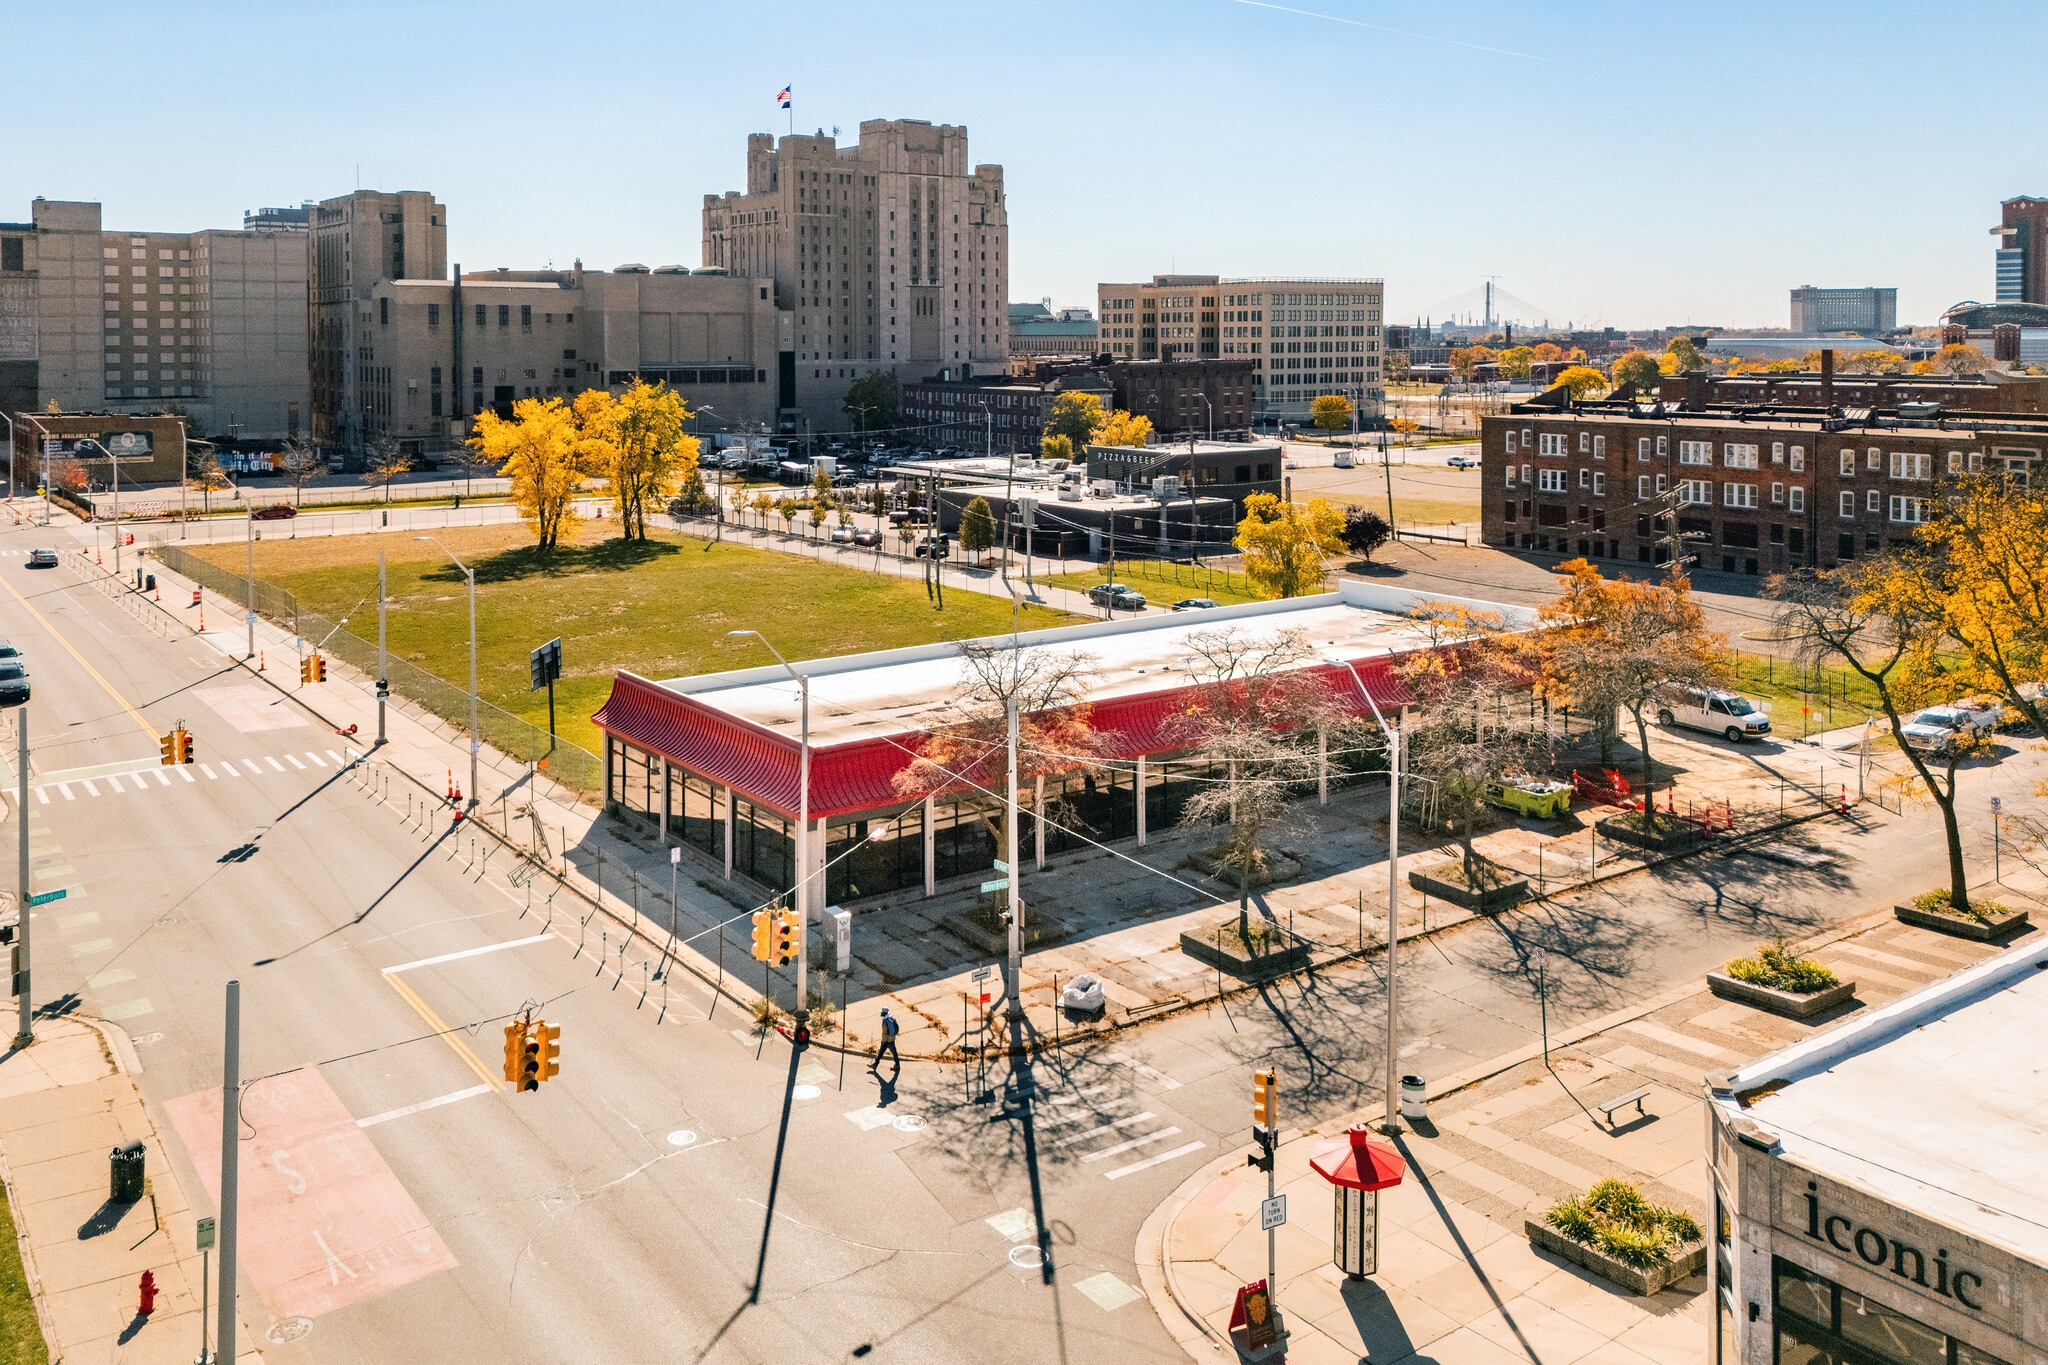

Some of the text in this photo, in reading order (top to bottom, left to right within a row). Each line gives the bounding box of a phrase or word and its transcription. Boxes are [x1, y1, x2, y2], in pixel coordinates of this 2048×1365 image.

[1097, 452, 1155, 464] PIZZA&BEER
[250, 460, 274, 472] City
[32, 891, 66, 905] Peterboro
[1271, 1200, 1279, 1208] NO
[1268, 1207, 1281, 1216] TURN
[1265, 1214, 1283, 1225] ON RED
[1803, 1181, 1983, 1311] iconic
